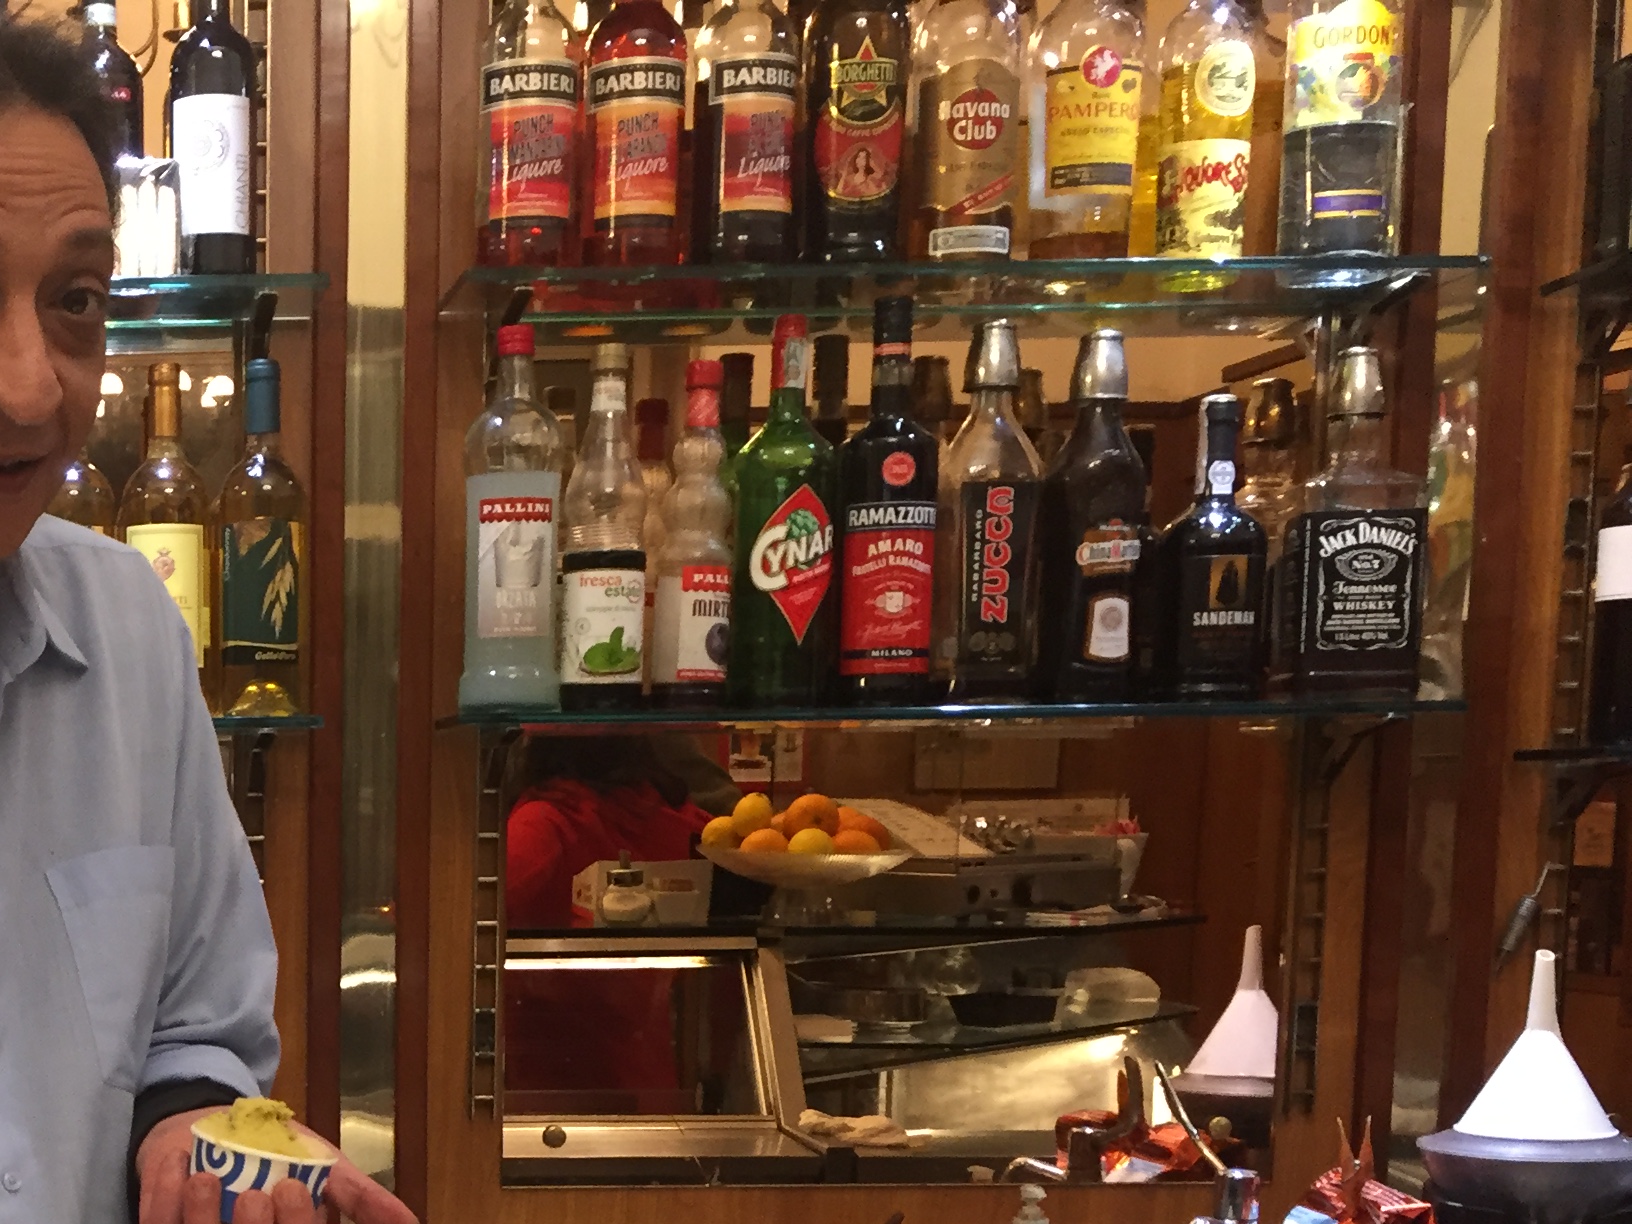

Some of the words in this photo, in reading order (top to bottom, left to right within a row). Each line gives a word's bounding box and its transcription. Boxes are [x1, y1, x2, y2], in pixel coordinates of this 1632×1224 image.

[490, 72, 574, 96] BARBIERI
[595, 71, 681, 95] BARBIERI
[1047, 101, 1139, 121] PAMPERO
[513, 113, 554, 136] PUNCH
[618, 112, 660, 136] PUNCH
[953, 120, 997, 141] Club
[482, 502, 550, 515] PALLINI
[867, 538, 924, 557] AMARO
[1319, 528, 1358, 558] JACK
[1358, 522, 1418, 555] DANIEL'S
[749, 523, 834, 592] CYNAR
[579, 574, 623, 588] fresca
[1333, 600, 1396, 610] WHISKEY
[1193, 611, 1255, 626] SANDEMAN
[870, 649, 914, 657] MILANO
